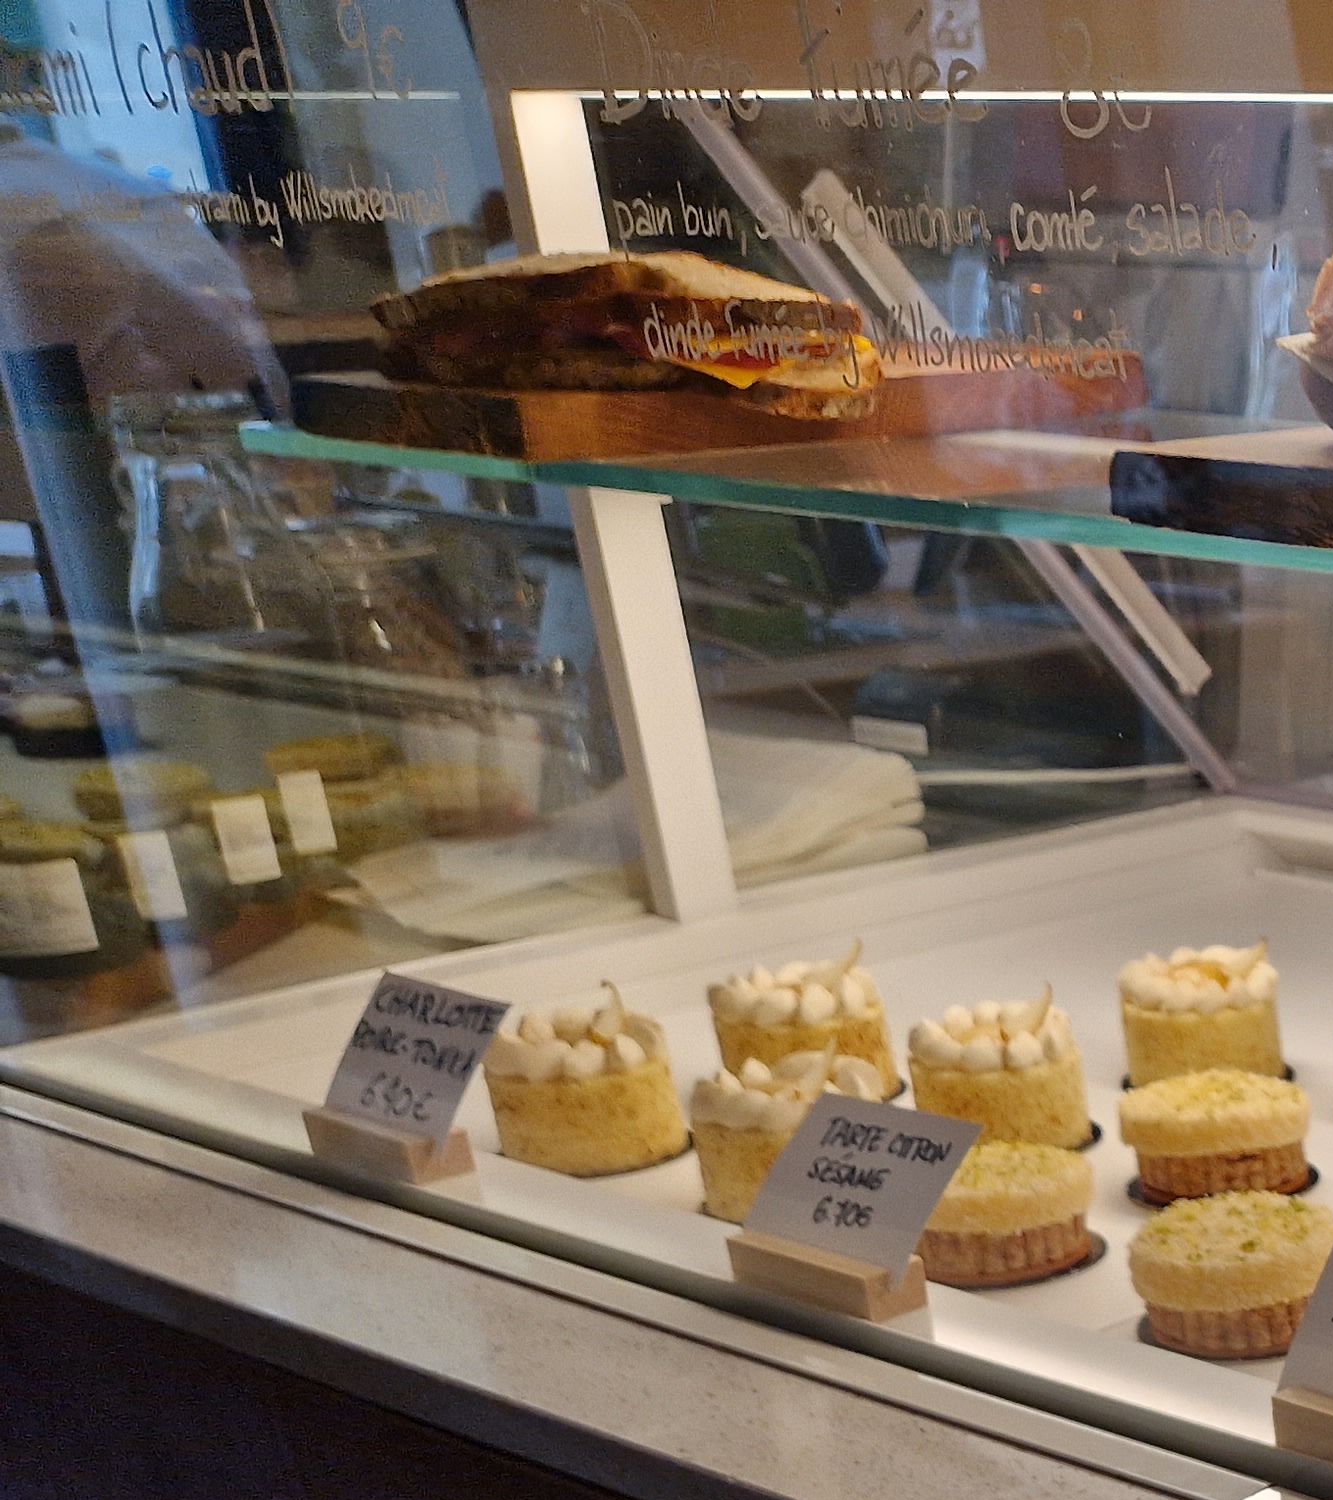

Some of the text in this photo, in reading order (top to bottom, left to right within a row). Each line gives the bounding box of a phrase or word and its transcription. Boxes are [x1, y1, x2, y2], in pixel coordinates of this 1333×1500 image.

[247, 172, 285, 250] by
[612, 190, 673, 264] pain
[642, 302, 720, 363] dinde
[820, 1116, 953, 1165] TARTE CITRON
